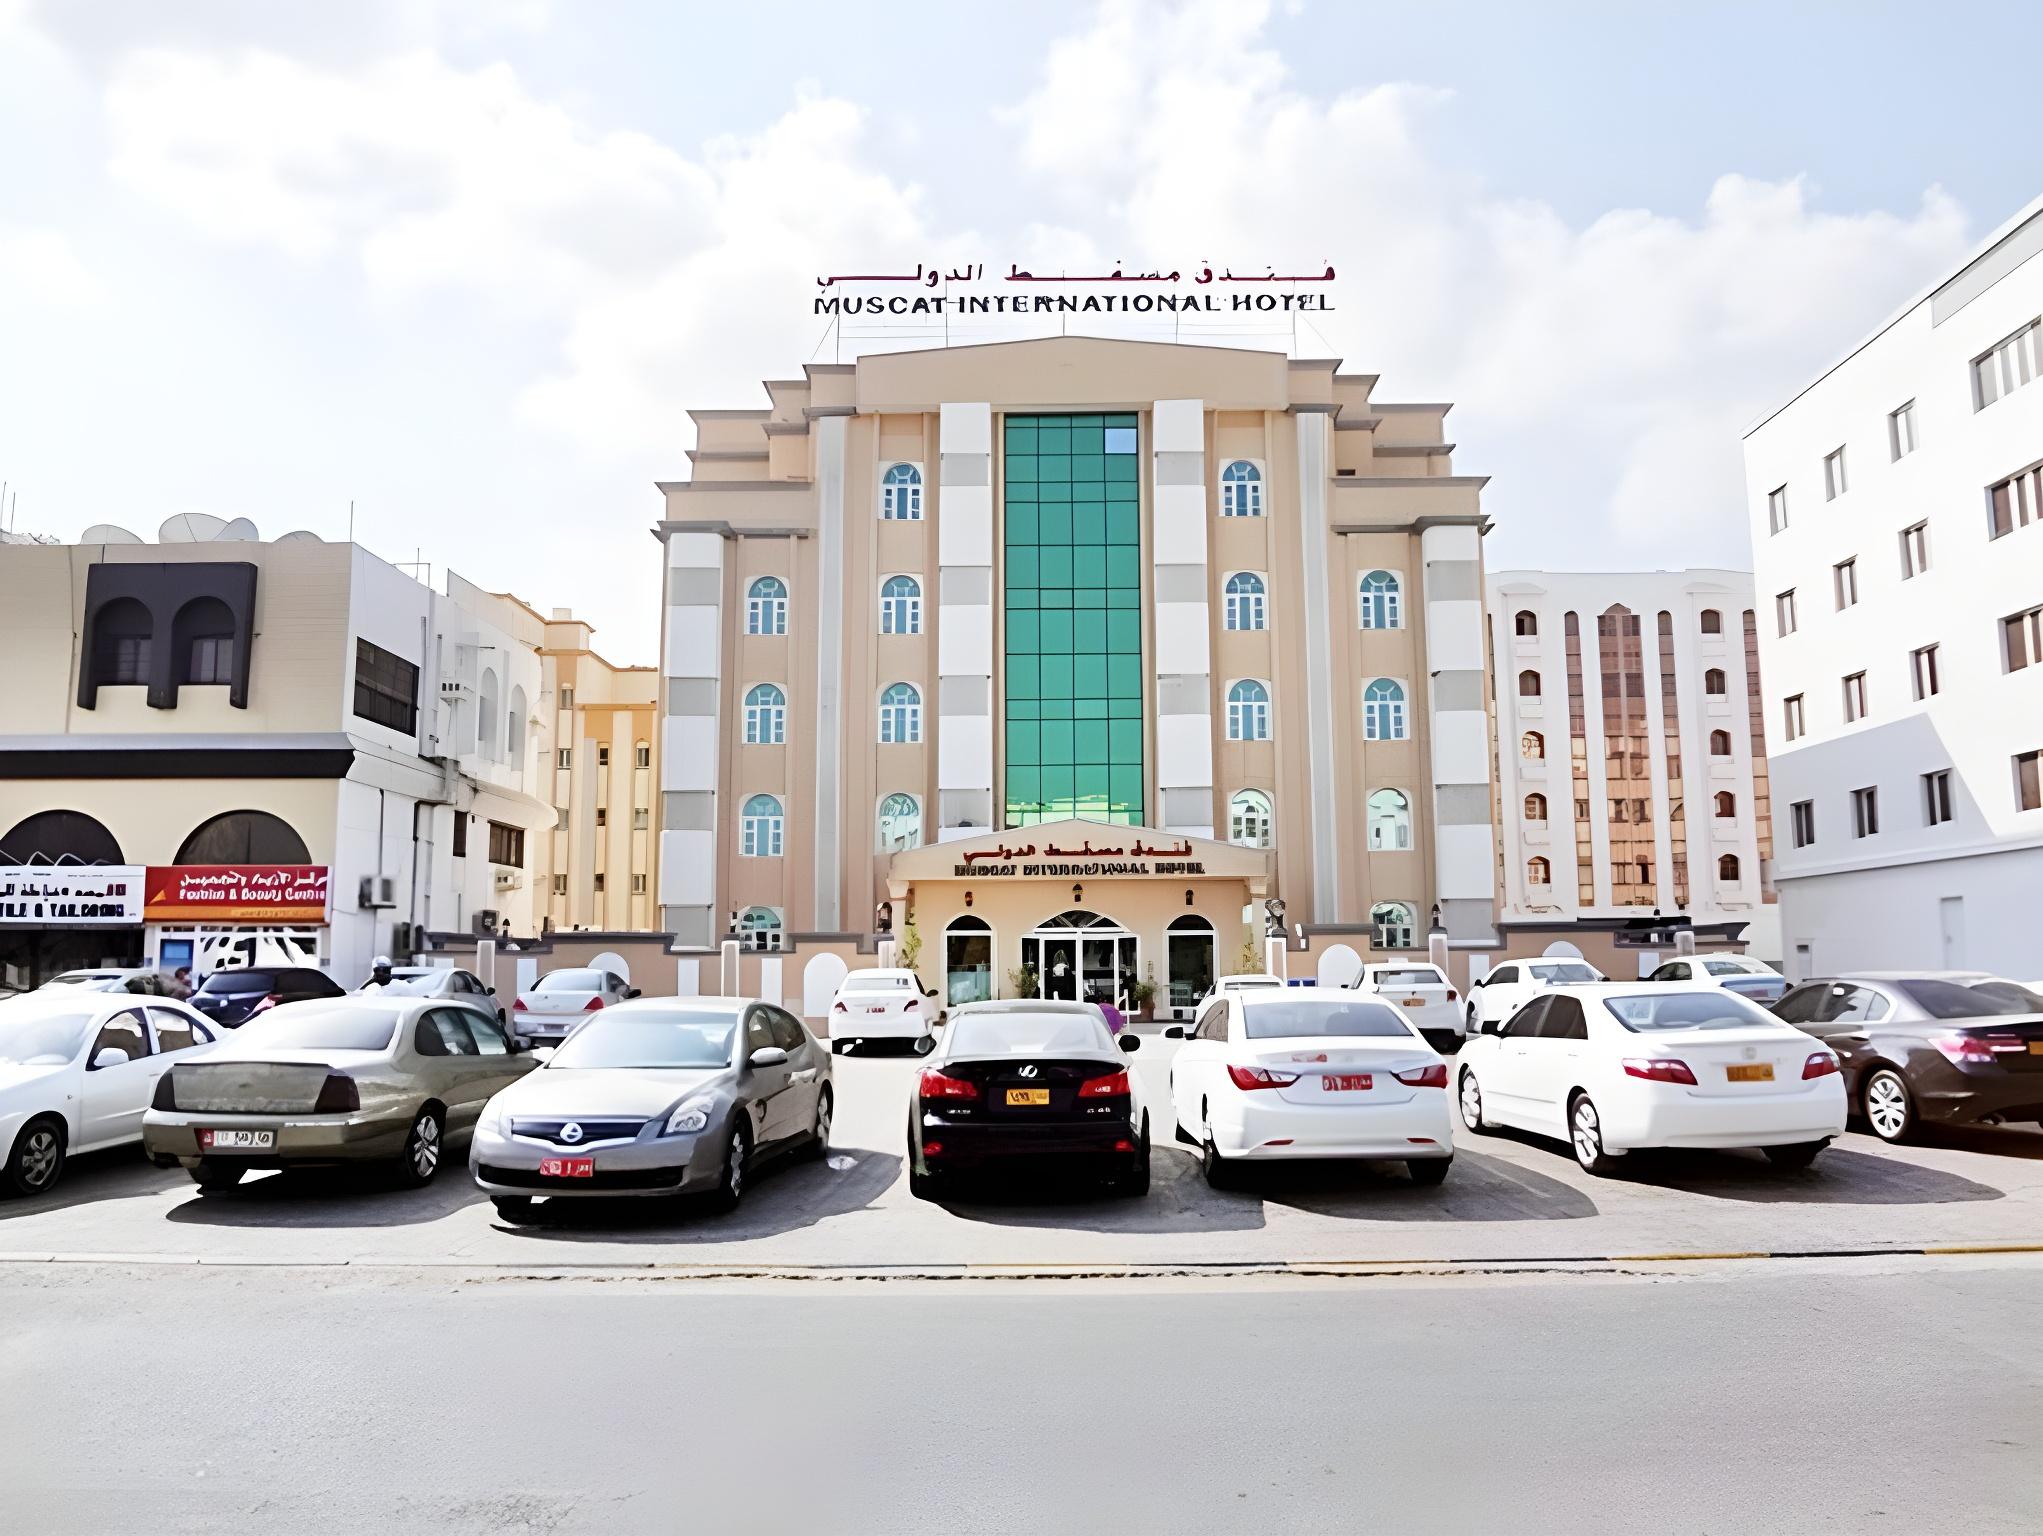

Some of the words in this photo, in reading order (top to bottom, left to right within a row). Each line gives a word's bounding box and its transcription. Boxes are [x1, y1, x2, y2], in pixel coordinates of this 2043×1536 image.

[813, 296, 947, 315] MUSCAT
[957, 294, 1222, 314] INTERNATIONAL
[1231, 294, 1336, 312] HOTEL
